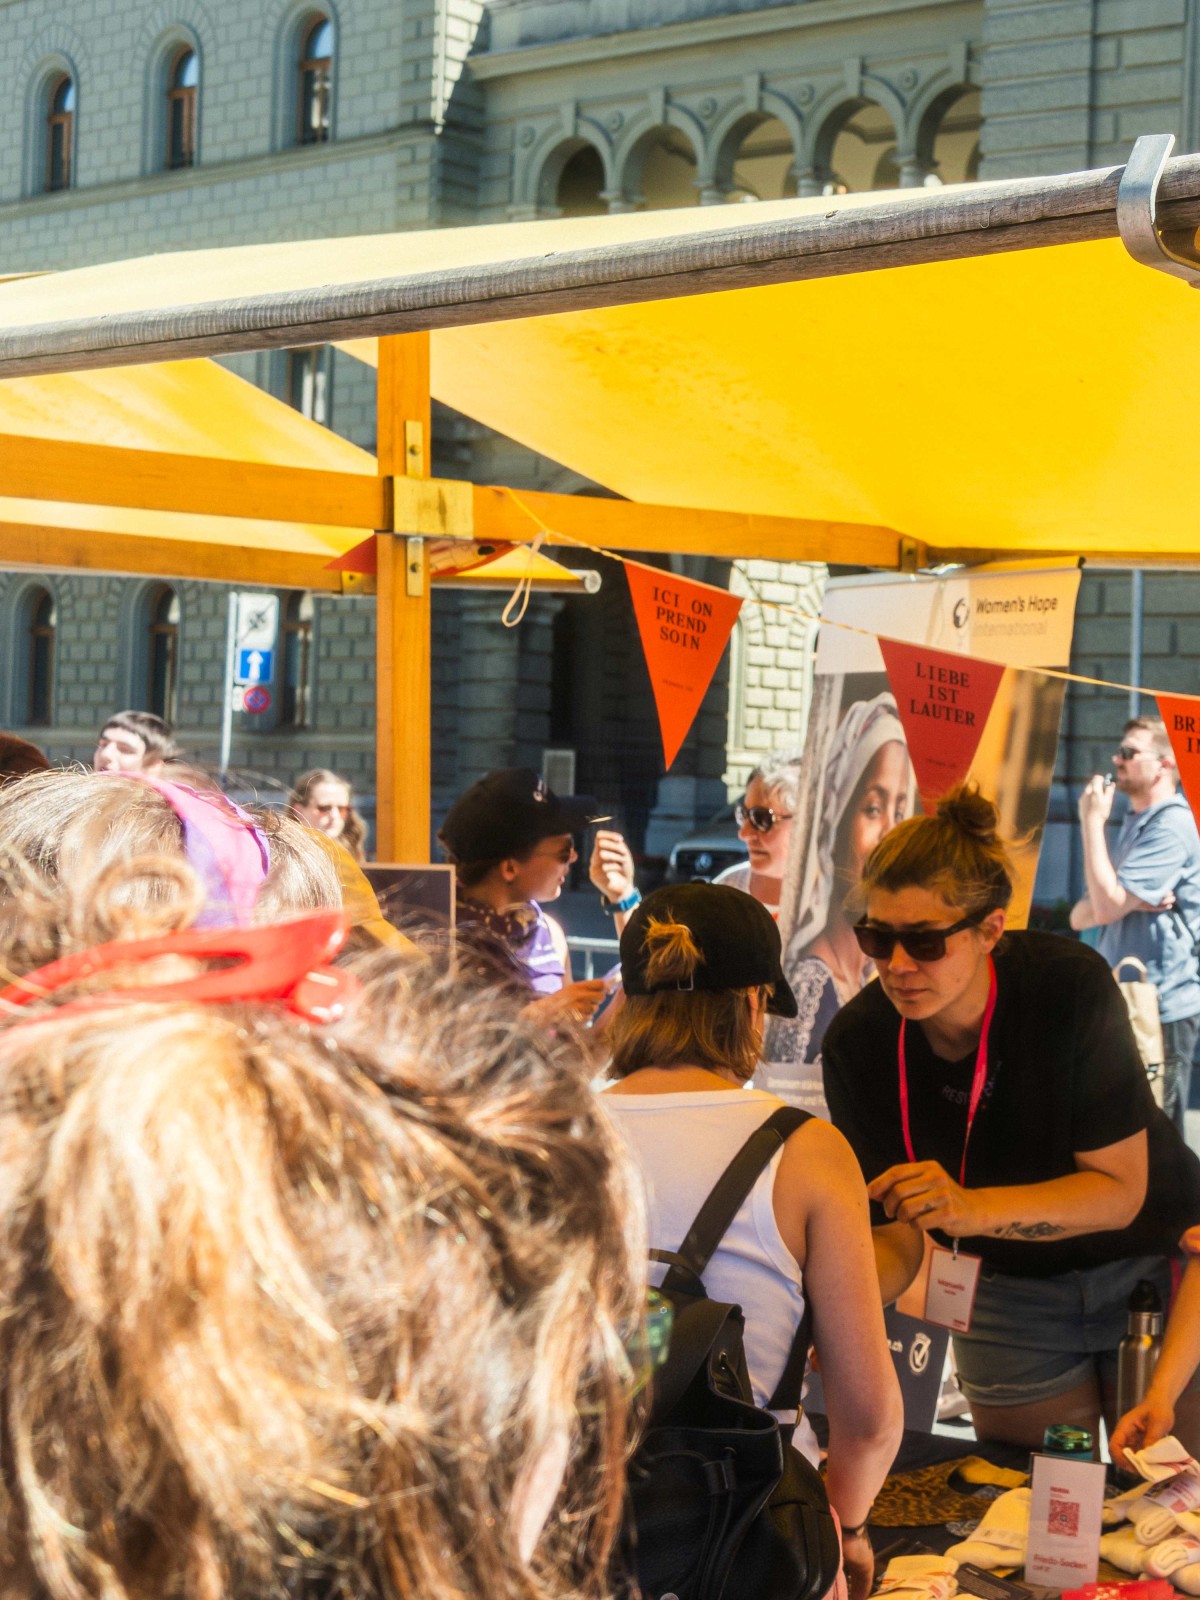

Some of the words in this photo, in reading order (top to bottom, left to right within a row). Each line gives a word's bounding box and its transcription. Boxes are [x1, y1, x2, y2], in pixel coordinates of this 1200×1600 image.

[652, 586, 680, 607] ICI
[691, 600, 713, 617] ON
[976, 596, 1025, 614] Women's
[1028, 596, 1058, 613] Hope
[656, 605, 707, 634] PREND
[659, 626, 700, 650] SOIN
[916, 662, 970, 688] LIEBE
[928, 686, 960, 704] IST
[910, 699, 976, 727] LAUTER
